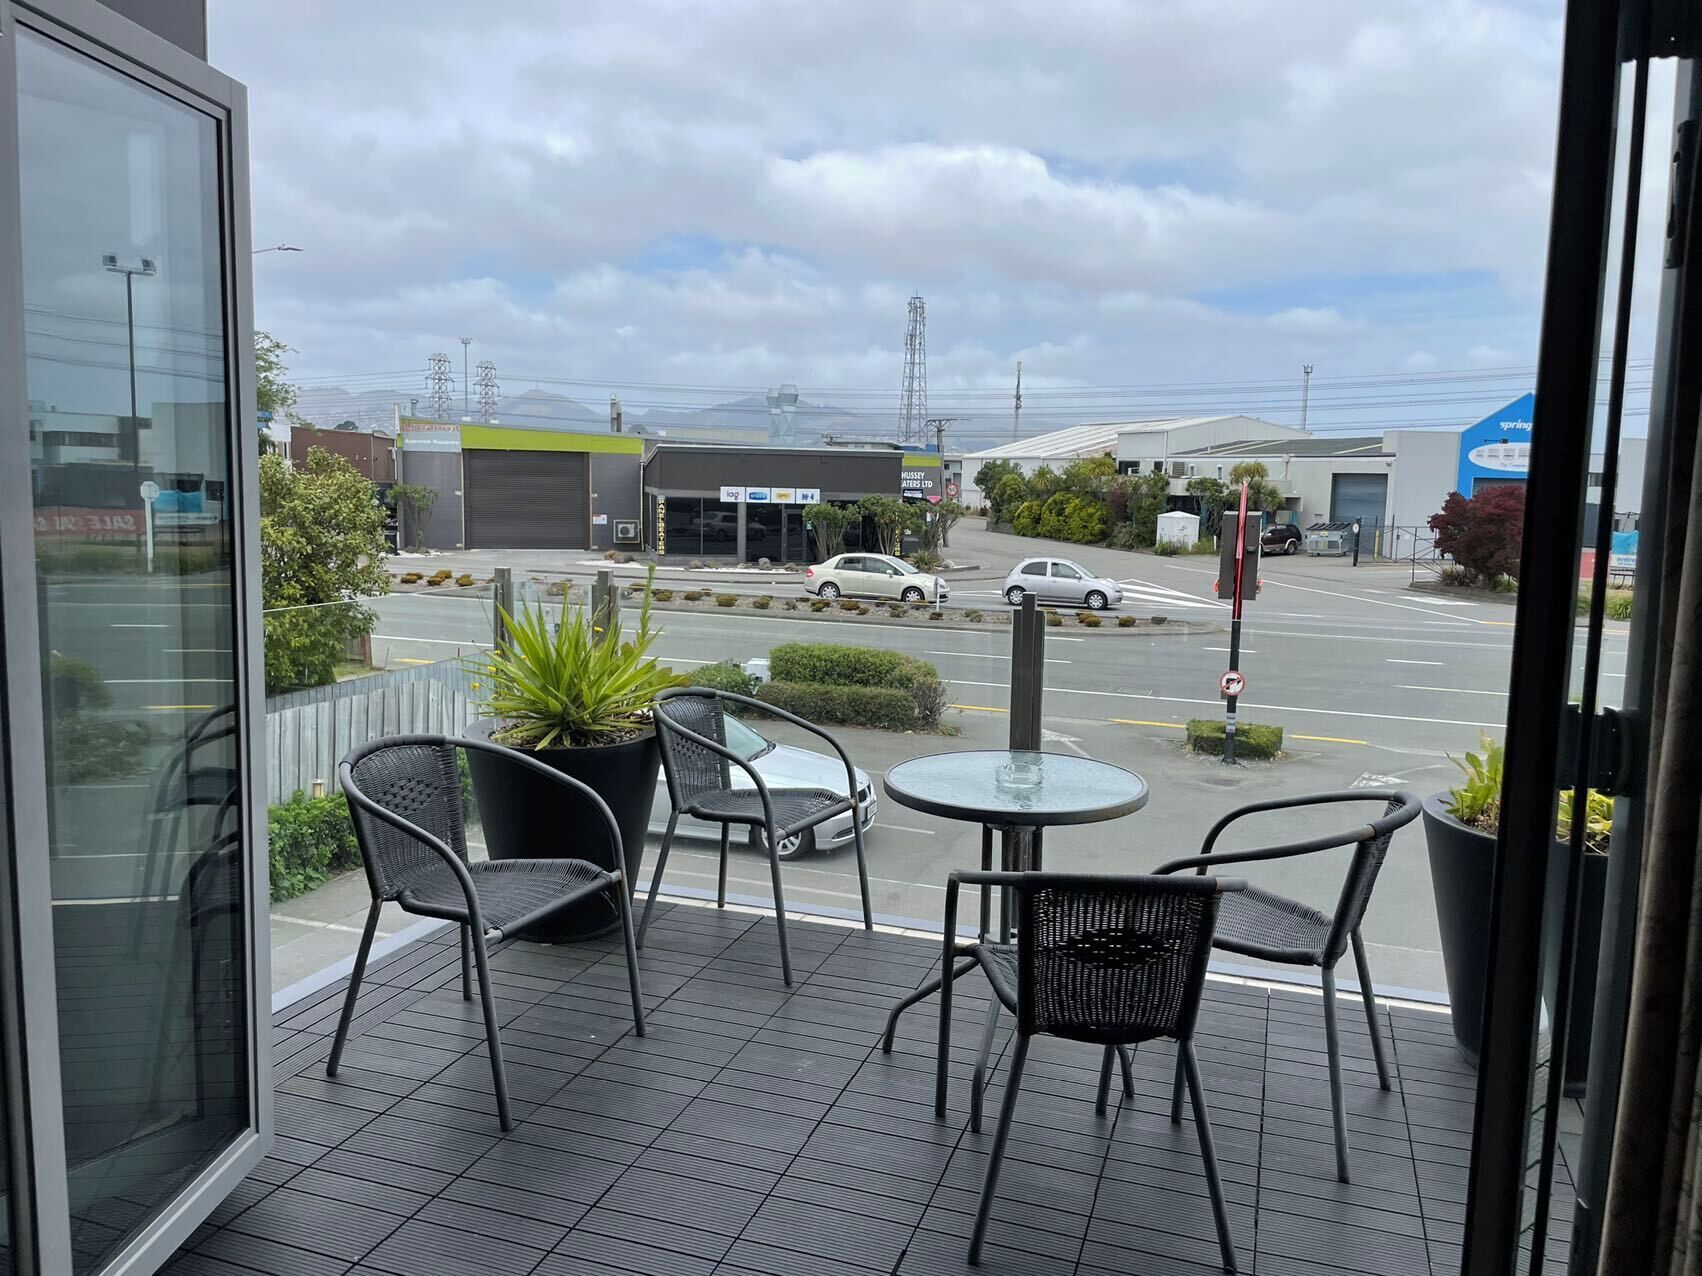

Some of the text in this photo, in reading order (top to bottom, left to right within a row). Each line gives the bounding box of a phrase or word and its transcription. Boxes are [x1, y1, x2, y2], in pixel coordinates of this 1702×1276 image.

[1499, 419, 1532, 431] spring
[901, 471, 926, 480] HUSSEY
[921, 480, 933, 488] LTD
